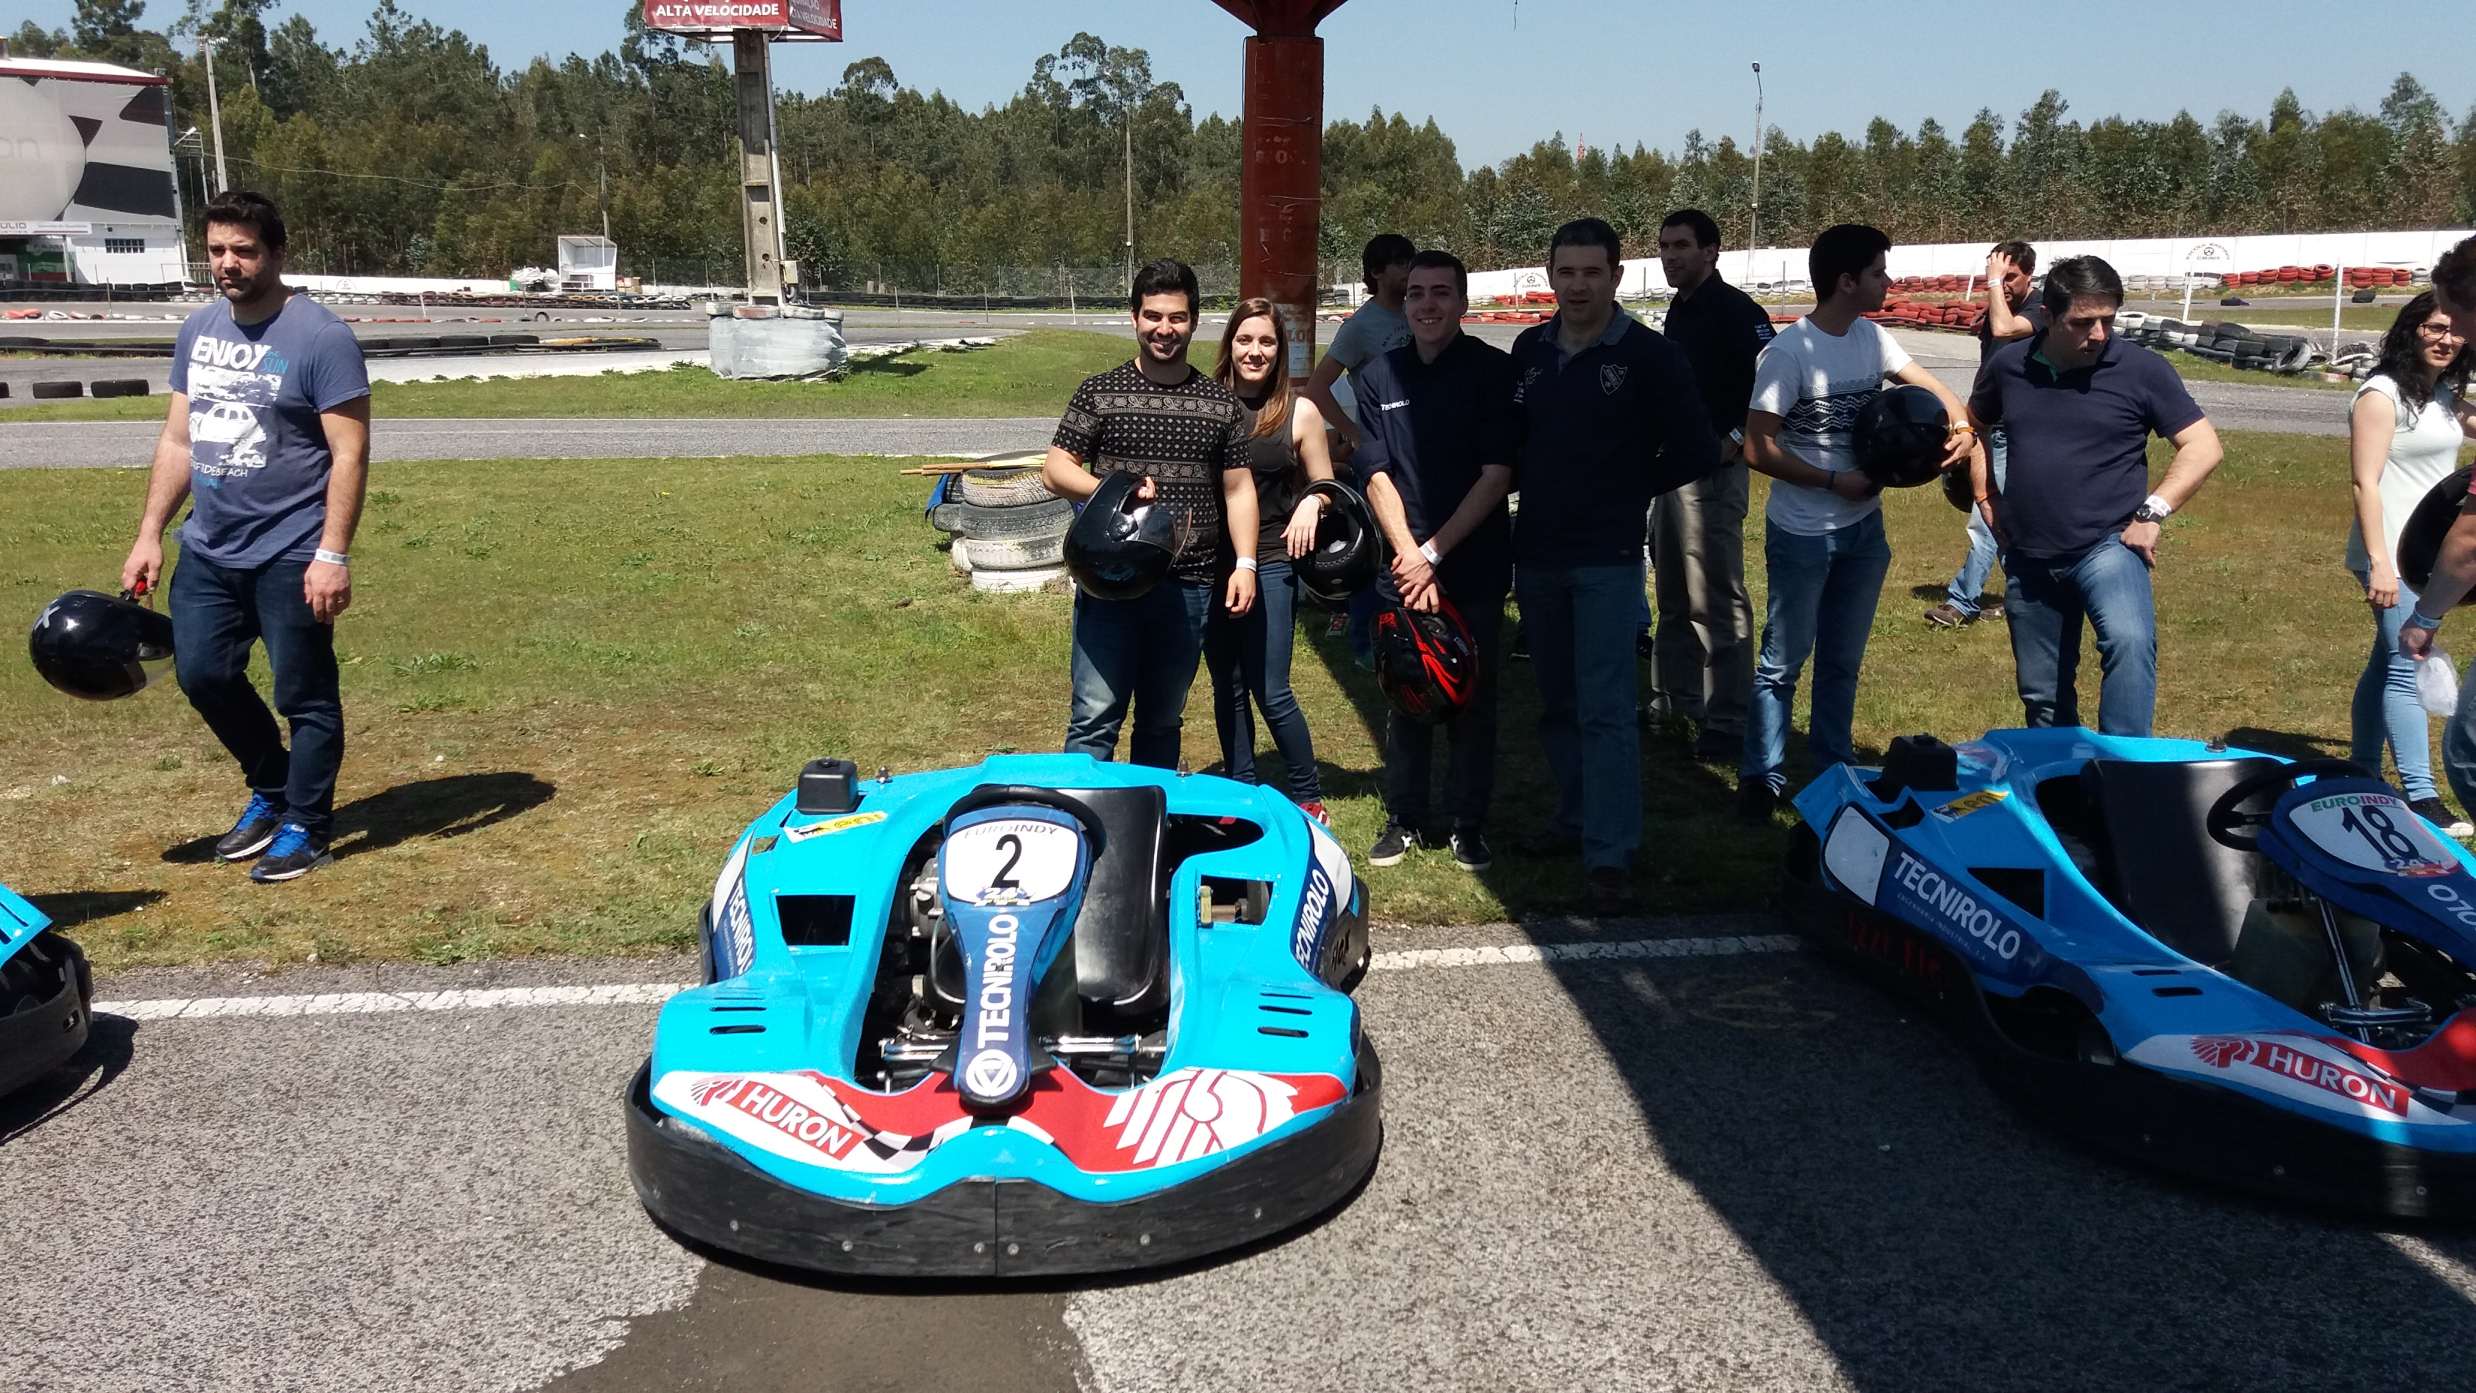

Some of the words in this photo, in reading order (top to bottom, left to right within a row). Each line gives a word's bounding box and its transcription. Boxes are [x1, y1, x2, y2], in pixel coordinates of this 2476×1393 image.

[655, 5, 691, 17] ALTA
[695, 4, 780, 17] VELOCIDADE
[190, 335, 272, 370] ENJOY
[2310, 795, 2399, 813] EUROINDY
[2341, 804, 2421, 861] 18
[991, 833, 1023, 889] 2
[729, 877, 754, 976] TECNIROL
[1295, 868, 1330, 969] ECNIROLO
[1894, 851, 2021, 960] TECNIROLO
[977, 913, 1020, 1050] TECNIROLO
[2268, 1046, 2396, 1110] HURON
[740, 1084, 852, 1155] HURON
